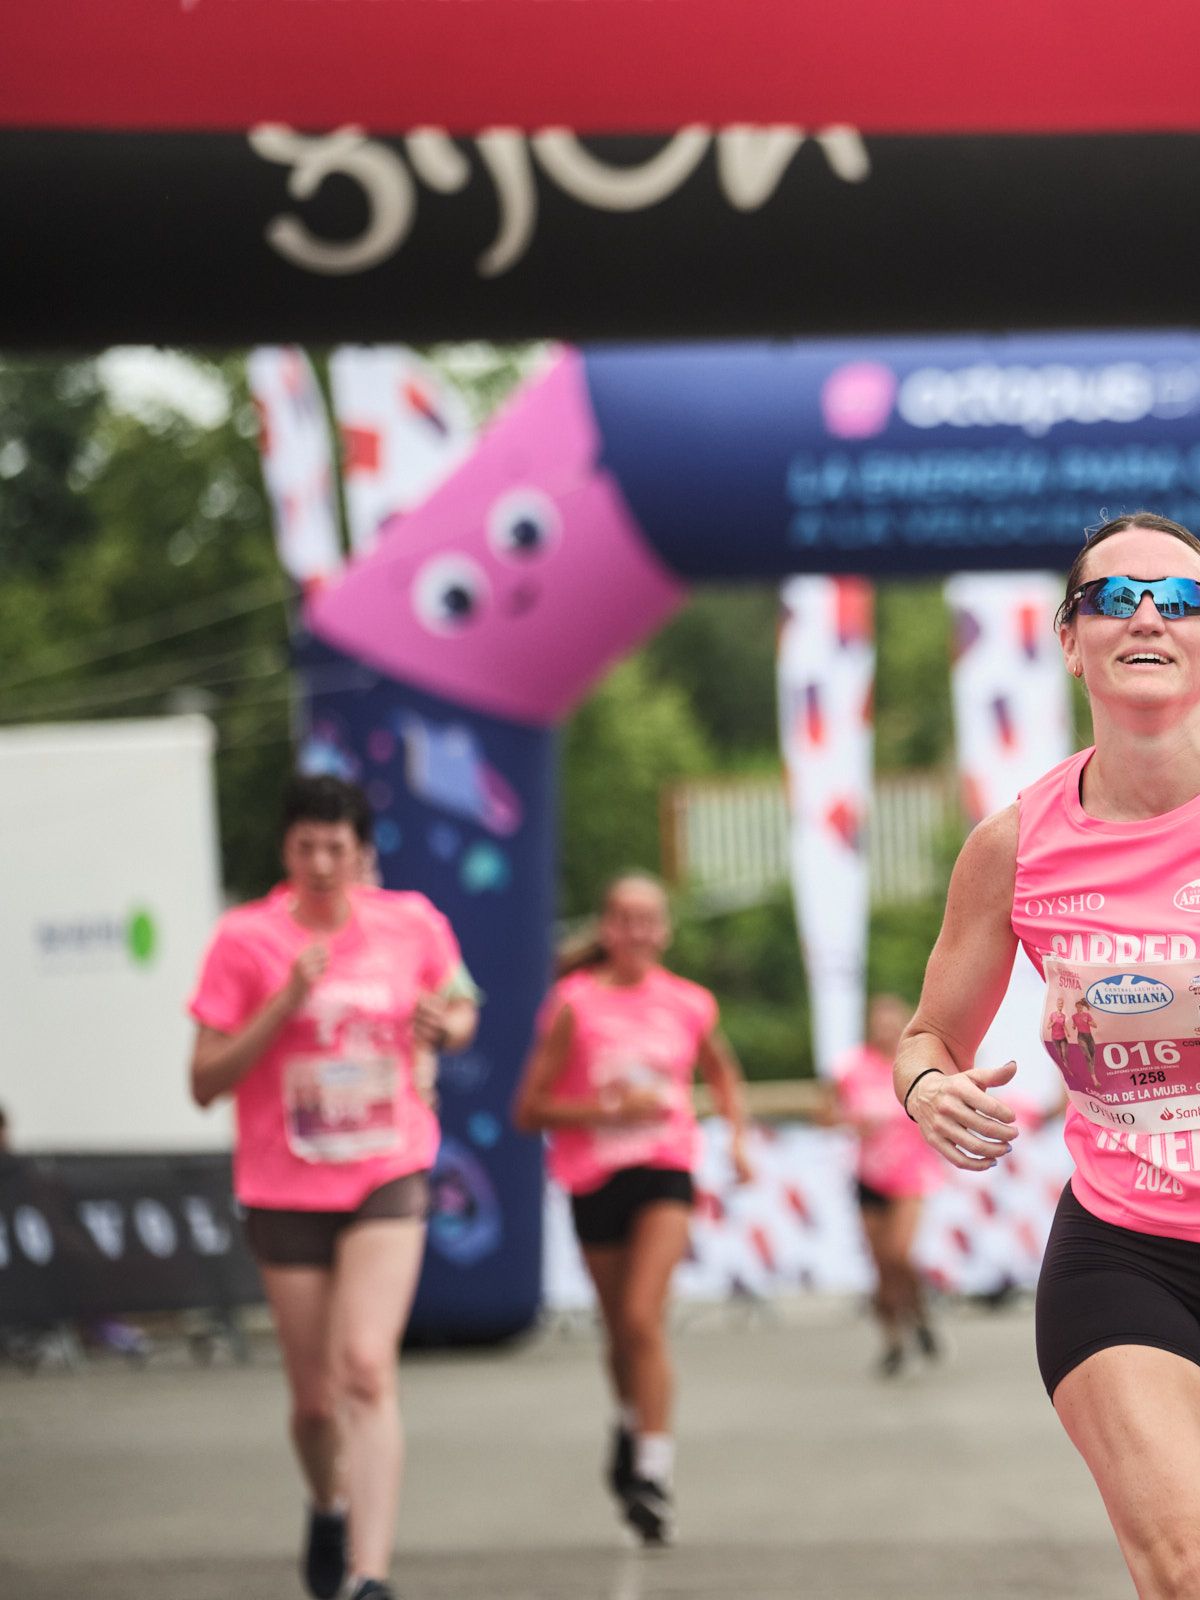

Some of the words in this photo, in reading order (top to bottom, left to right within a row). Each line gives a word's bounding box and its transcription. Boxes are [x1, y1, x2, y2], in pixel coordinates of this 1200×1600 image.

[1024, 892, 1105, 917] OYSHO
[1093, 989, 1167, 1005] ASTURIANA
[1103, 1041, 1181, 1070] 016
[1130, 1071, 1166, 1086] 1258
[1122, 1091, 1135, 1101] DE
[1138, 1089, 1151, 1099] LA
[1153, 1085, 1187, 1098] MUJER
